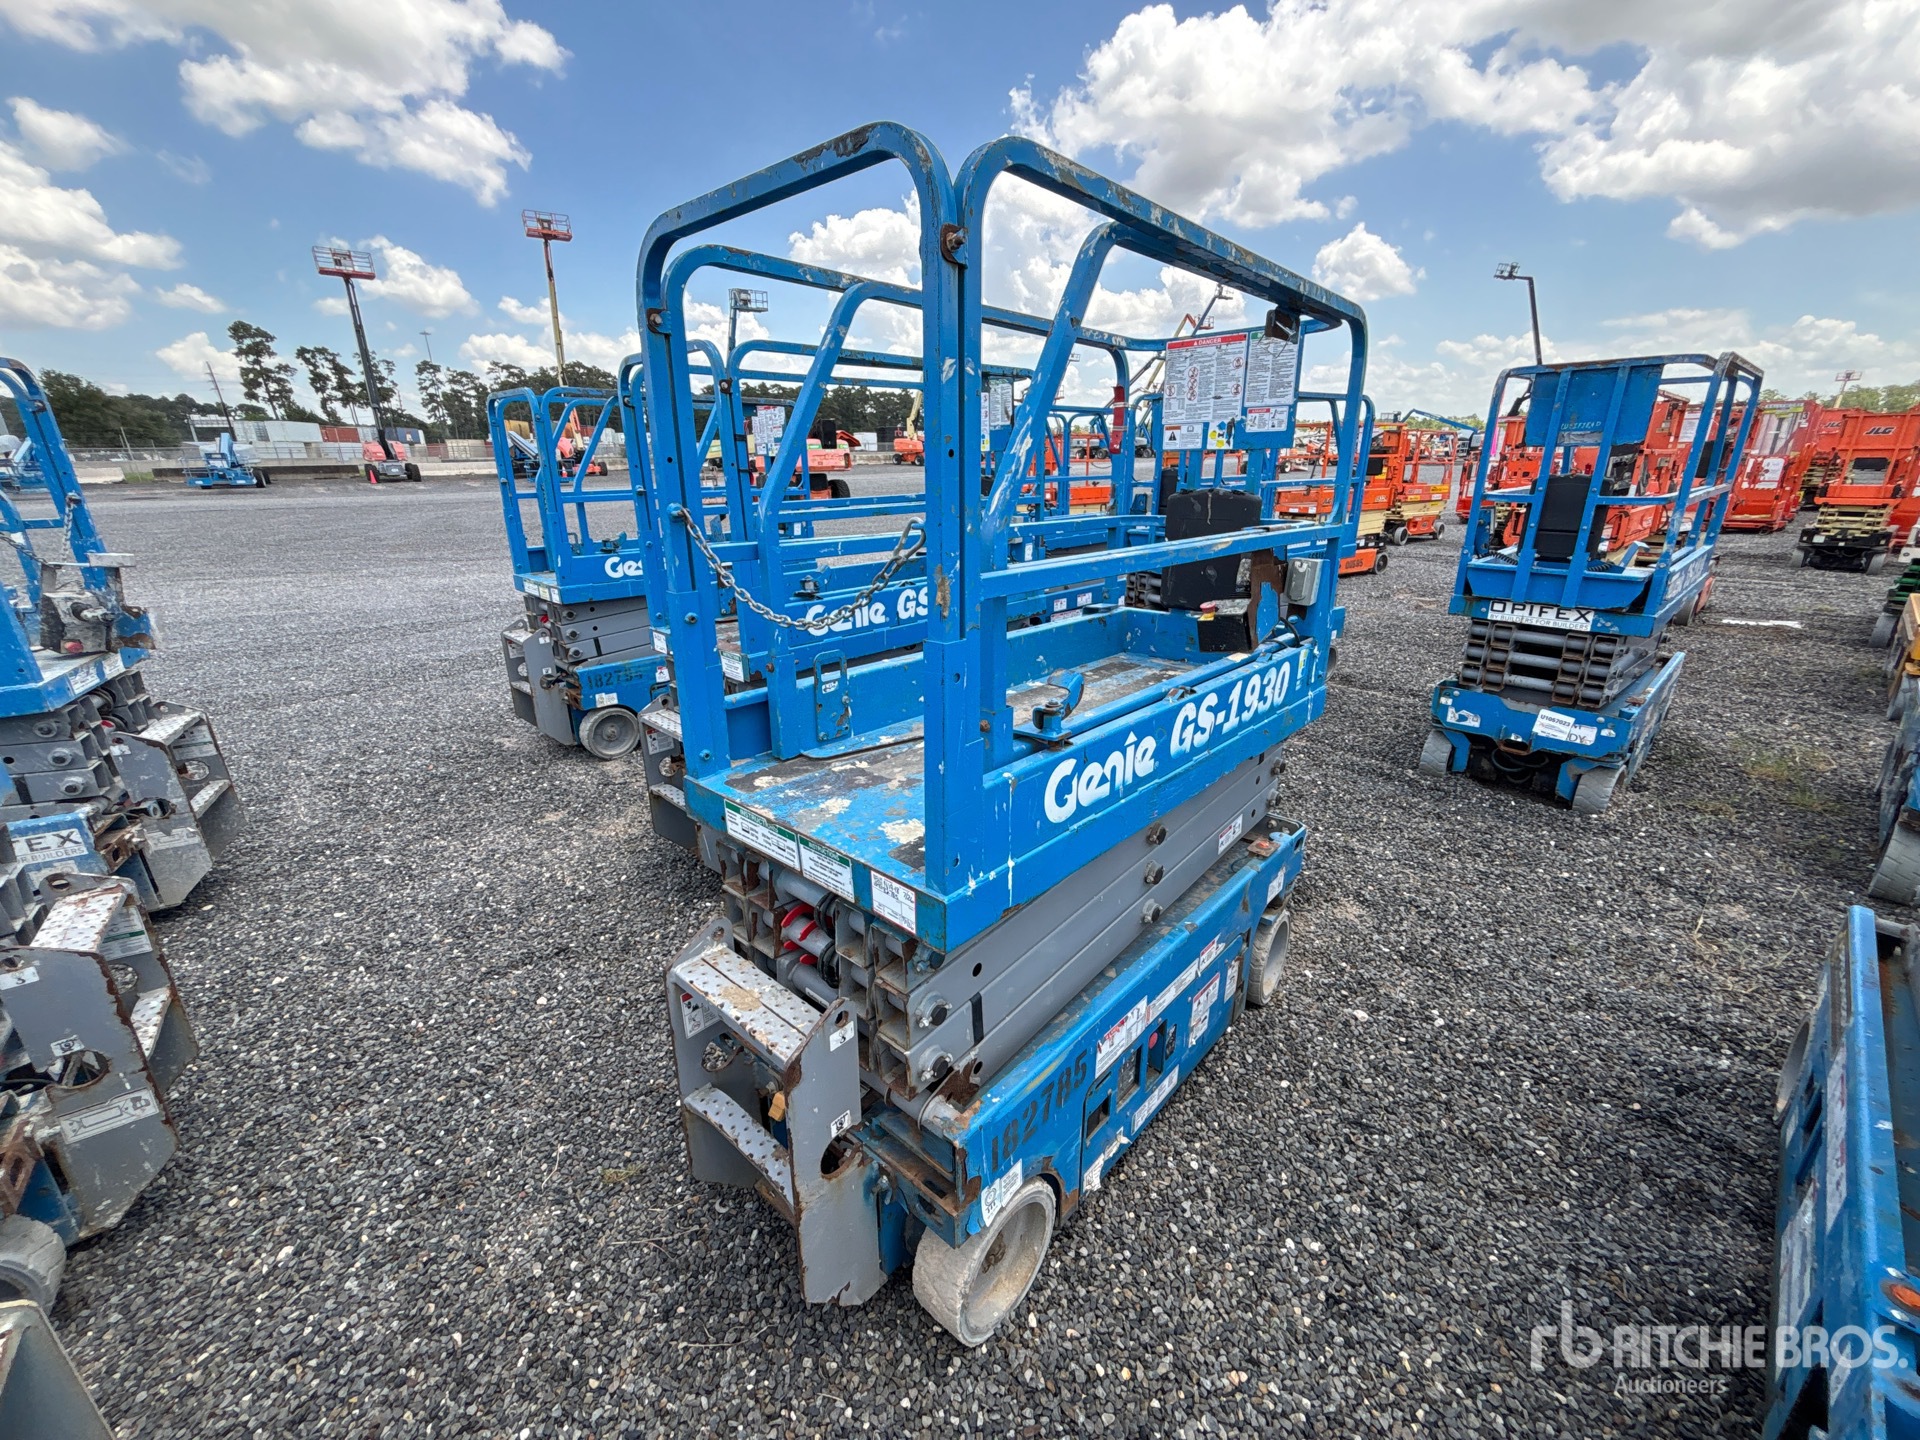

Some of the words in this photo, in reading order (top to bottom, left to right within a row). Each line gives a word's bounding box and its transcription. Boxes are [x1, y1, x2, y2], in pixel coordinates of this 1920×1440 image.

[1865, 426, 1896, 435] JLG
[1491, 601, 1592, 623] OPIFEX
[1500, 614, 1534, 625] BUILDERS
[1535, 618, 1552, 627] FOR
[1552, 621, 1590, 631] BUILDERS
[1044, 731, 1157, 824] Genie
[1170, 661, 1291, 760] GS-1930
[31, 847, 86, 861] BUILDERS
[991, 1050, 1088, 1173] 182785
